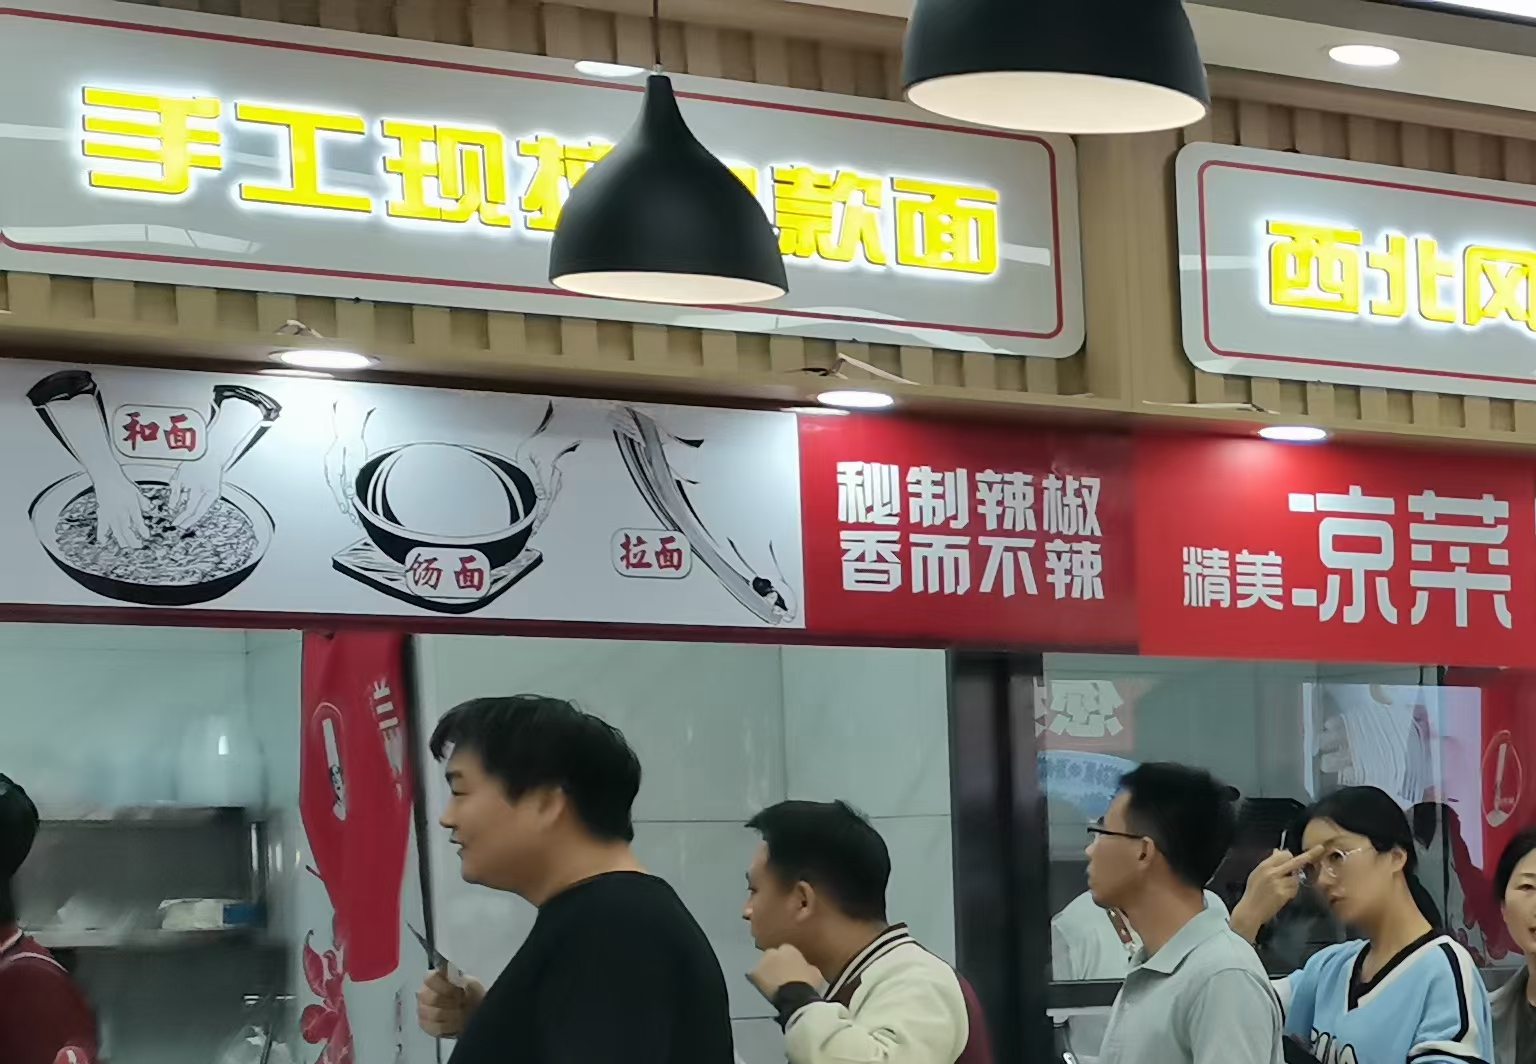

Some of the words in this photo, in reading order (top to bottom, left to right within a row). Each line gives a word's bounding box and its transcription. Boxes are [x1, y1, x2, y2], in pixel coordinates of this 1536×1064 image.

[122, 410, 198, 452] 和面
[836, 461, 1104, 538] 秘制辣椒
[617, 532, 684, 571] 拉面
[840, 529, 1106, 601] 香而不辣
